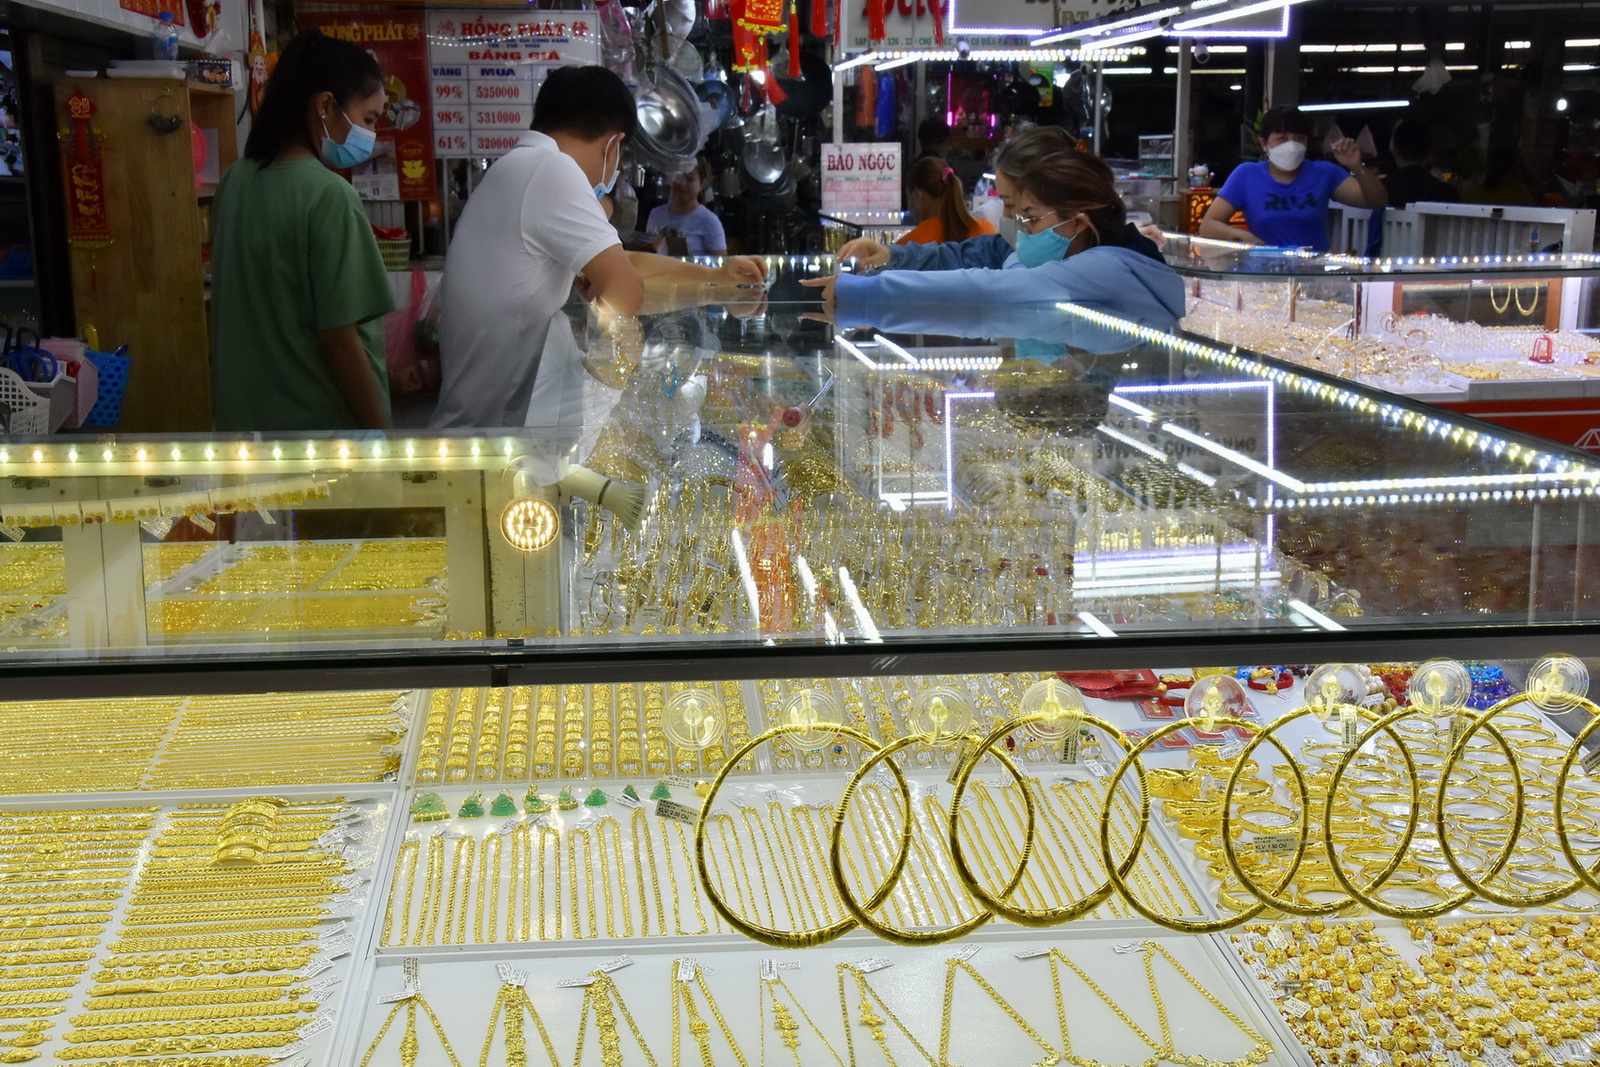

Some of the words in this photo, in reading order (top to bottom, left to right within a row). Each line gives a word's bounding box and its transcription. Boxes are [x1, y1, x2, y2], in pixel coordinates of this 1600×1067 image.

[362, 21, 405, 41] PHÁT
[460, 15, 511, 36] HỒNG
[517, 20, 566, 37] PHÁT
[468, 49, 522, 60] BẢNG
[528, 50, 560, 60] GIÁ
[432, 68, 462, 77] VÀNG
[480, 68, 516, 77] MUA
[436, 85, 464, 99] 99%
[476, 86, 520, 99] 5350000
[437, 111, 465, 124] 98%
[477, 111, 521, 124] 5310000
[438, 136, 467, 149] 61%
[827, 146, 854, 171] BẢO
[858, 153, 896, 175] NGỌC
